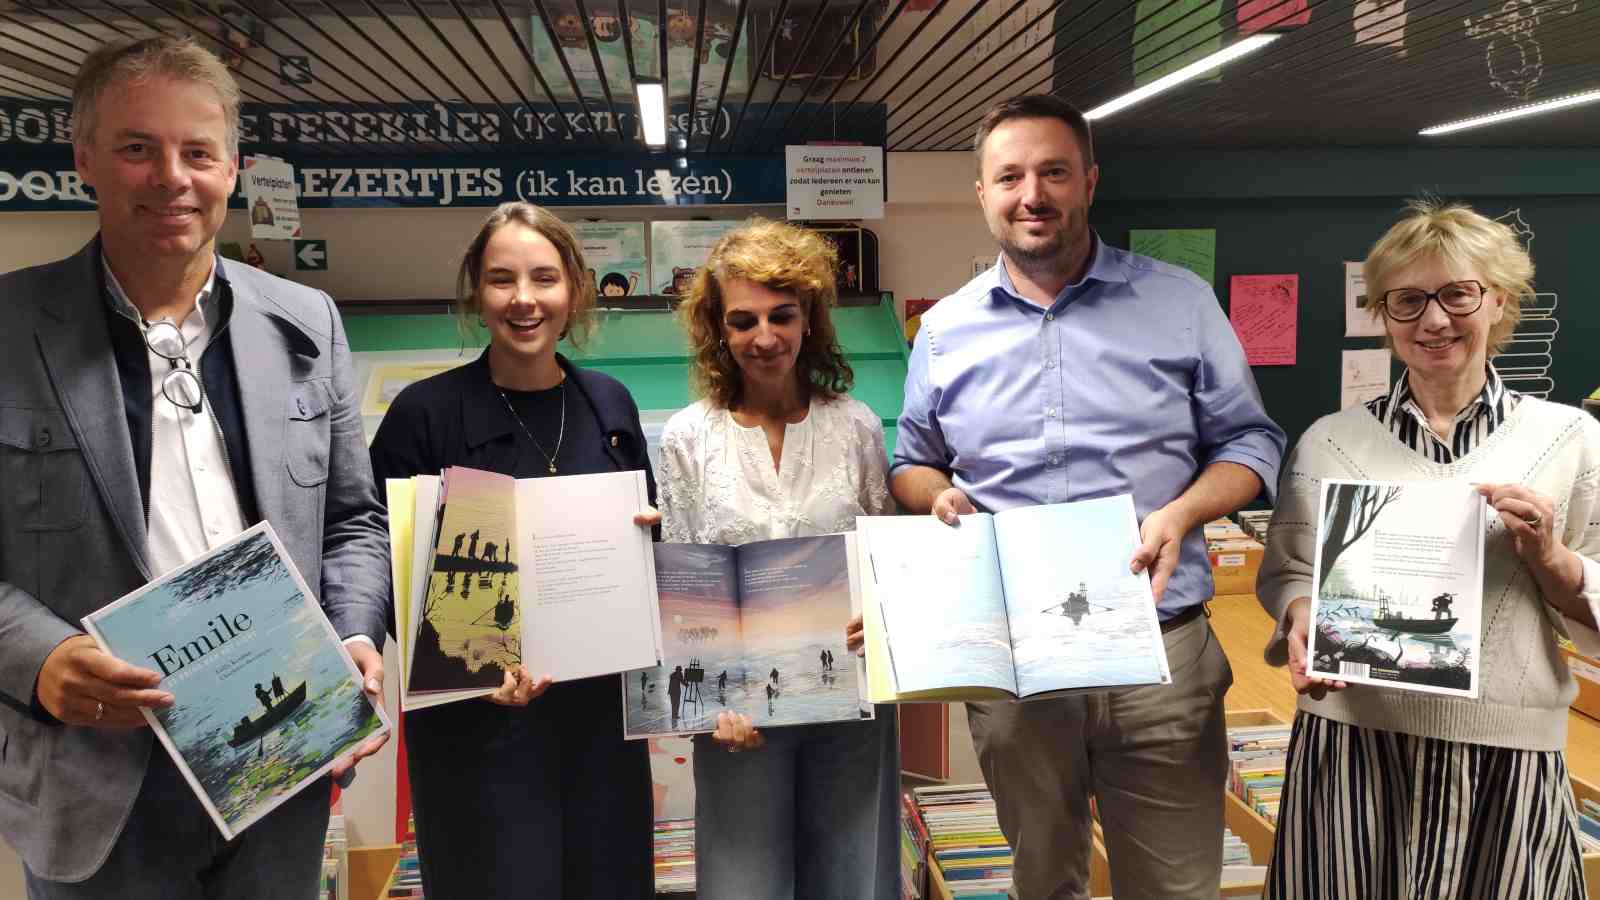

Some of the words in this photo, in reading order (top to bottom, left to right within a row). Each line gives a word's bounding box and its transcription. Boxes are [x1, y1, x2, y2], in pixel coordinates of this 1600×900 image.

[802, 155, 825, 164] Graag
[842, 166, 874, 174] ontlenen
[515, 170, 558, 201] (ik
[567, 170, 627, 196] kan
[635, 168, 732, 200] lezen)
[790, 177, 810, 185] zodat
[812, 177, 843, 185] iedereen
[820, 188, 852, 197] genieten
[149, 612, 252, 680] Emile
